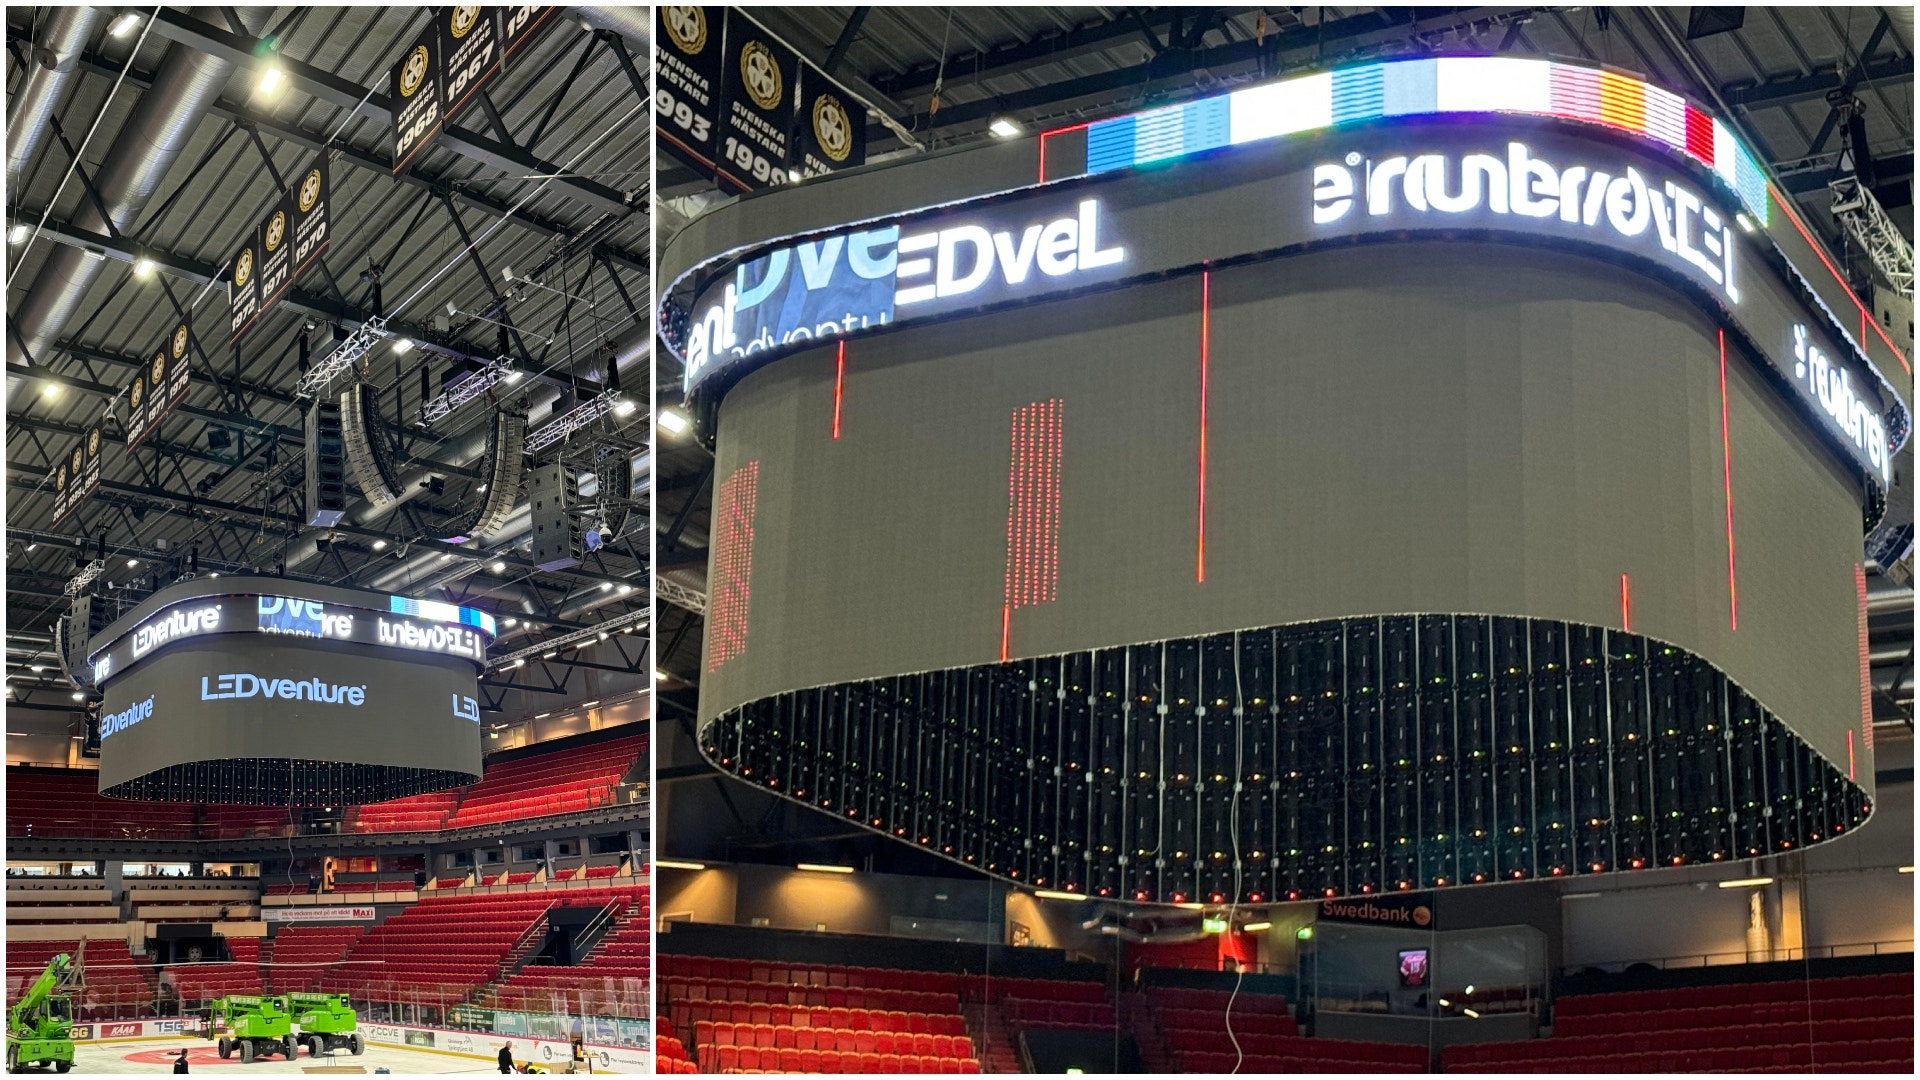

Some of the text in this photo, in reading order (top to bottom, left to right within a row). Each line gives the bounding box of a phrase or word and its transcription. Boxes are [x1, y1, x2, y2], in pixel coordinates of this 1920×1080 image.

[449, 18, 490, 67] SVENSKA
[447, 39, 495, 103] 1967
[398, 80, 434, 124] SVENSKA
[732, 101, 785, 145] SVENSKA
[396, 101, 438, 158] 1968
[731, 115, 785, 159] MÄSTARE
[296, 222, 326, 264] 1970
[263, 263, 288, 299] 1971
[232, 297, 256, 332] 1972
[1323, 901, 1411, 922] Swedbank
[154, 1021, 184, 1033] TSG
